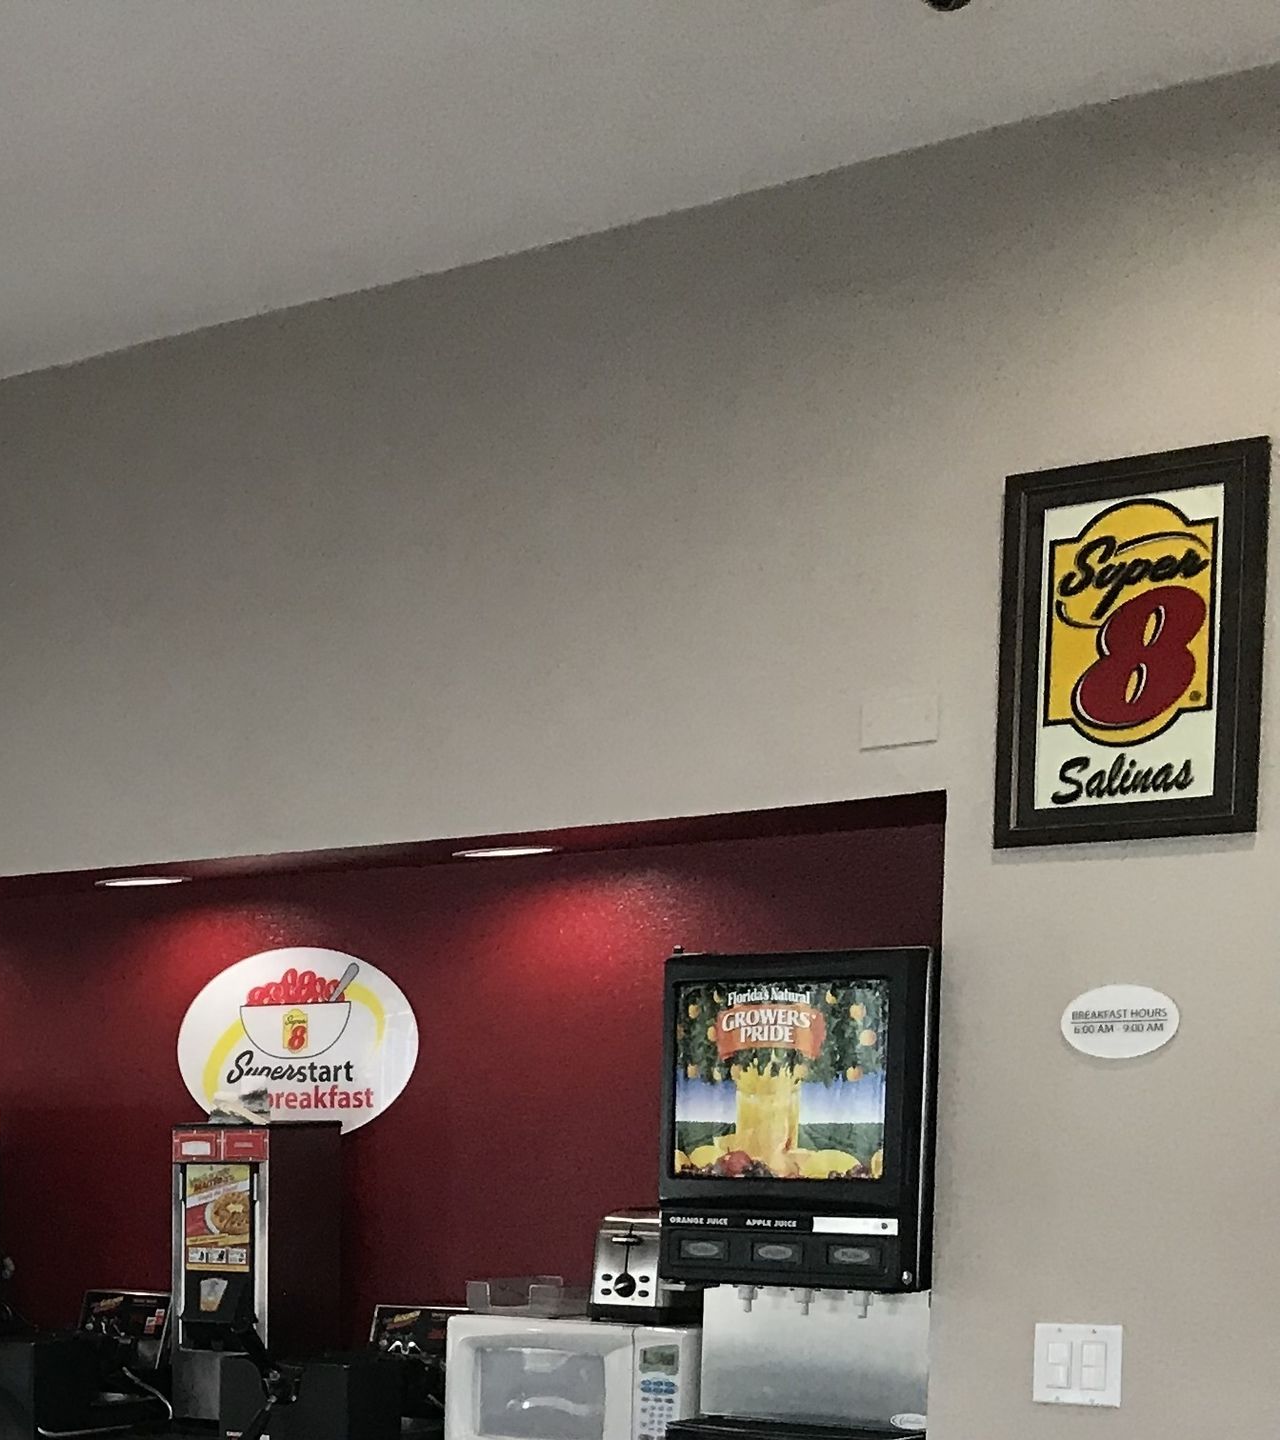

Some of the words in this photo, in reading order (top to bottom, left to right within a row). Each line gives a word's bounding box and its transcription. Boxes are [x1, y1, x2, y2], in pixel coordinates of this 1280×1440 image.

[1055, 533, 1212, 621] Super
[1070, 584, 1207, 730] 8
[1051, 752, 1195, 805] Salinas
[727, 986, 770, 1006] Florida's
[771, 986, 811, 1005] Natural
[1071, 1008, 1128, 1021] BREAKFAST
[1130, 1007, 1168, 1019] HOURS
[740, 1025, 795, 1043] PRIDE
[1097, 1023, 1114, 1034] AM
[1146, 1022, 1164, 1032] AM
[288, 1025, 307, 1051] 8
[669, 1216, 704, 1225] ORANGE
[706, 1217, 728, 1226] JUICE
[745, 1218, 772, 1227] APPLE
[773, 1220, 797, 1228] JUICE
